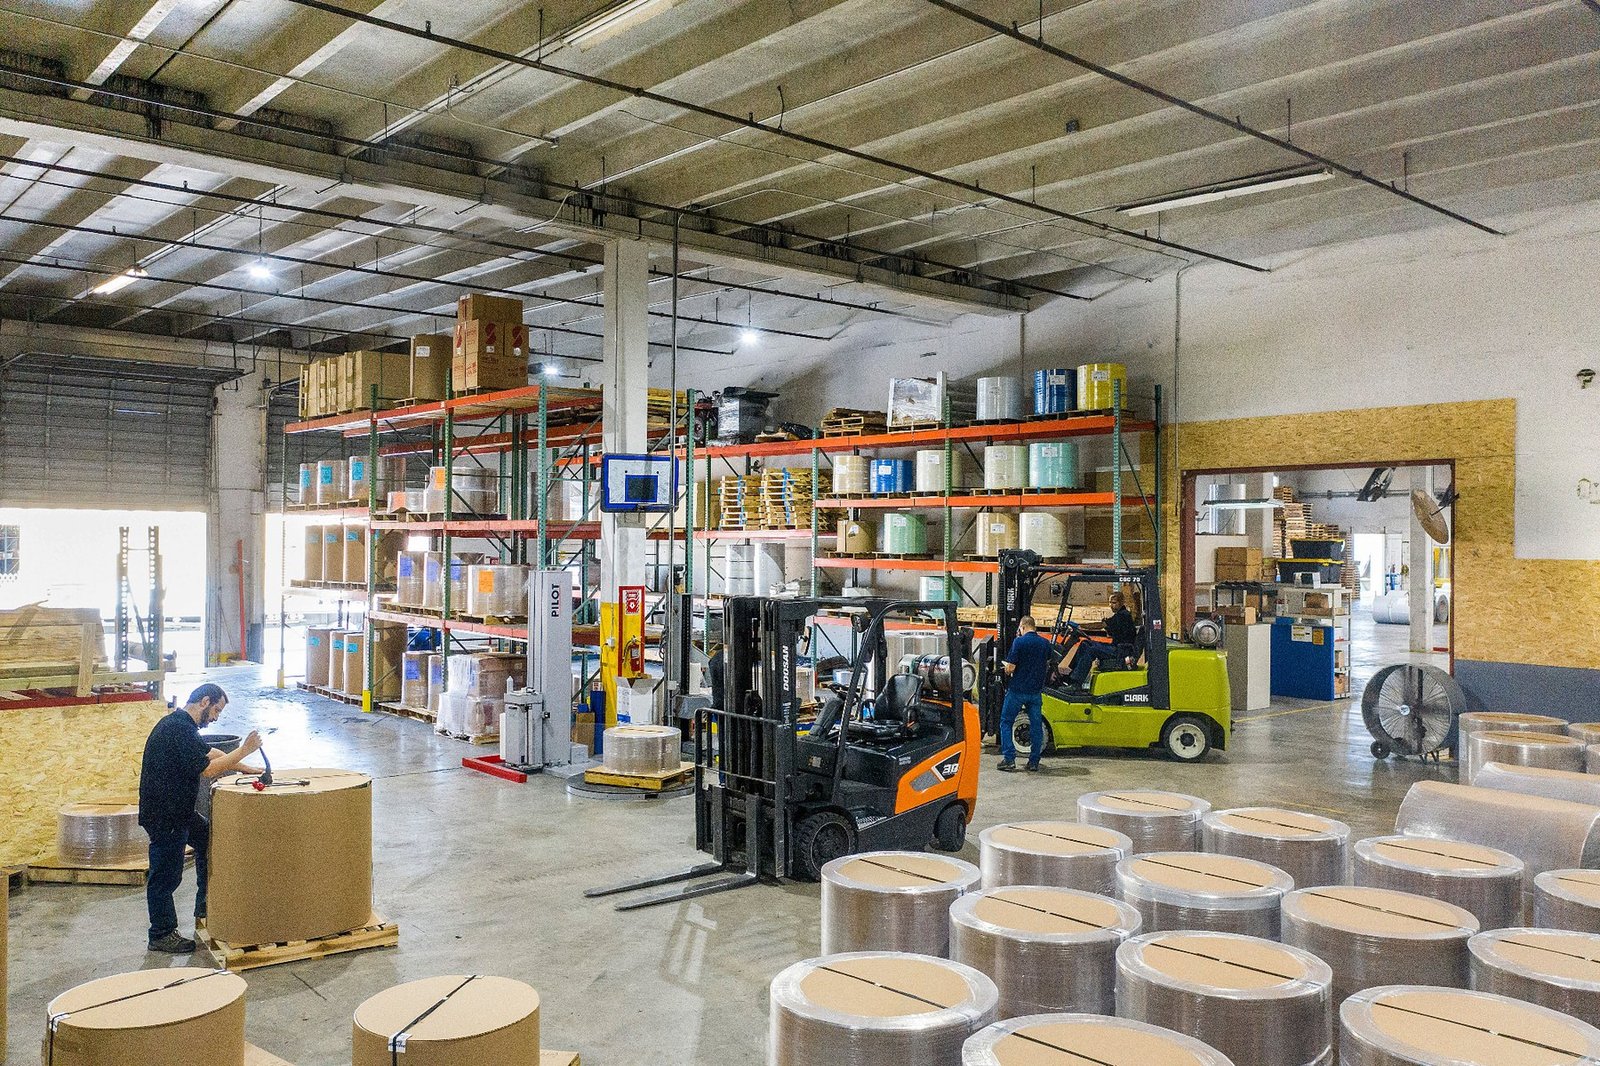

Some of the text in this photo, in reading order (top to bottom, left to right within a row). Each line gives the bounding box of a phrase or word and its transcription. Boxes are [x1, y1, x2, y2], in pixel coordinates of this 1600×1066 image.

[551, 583, 560, 617] PILOT
[1007, 587, 1015, 611] CLARK
[782, 645, 790, 692] DOOSAN
[1124, 694, 1149, 702] CLARK
[942, 763, 959, 775] 30
